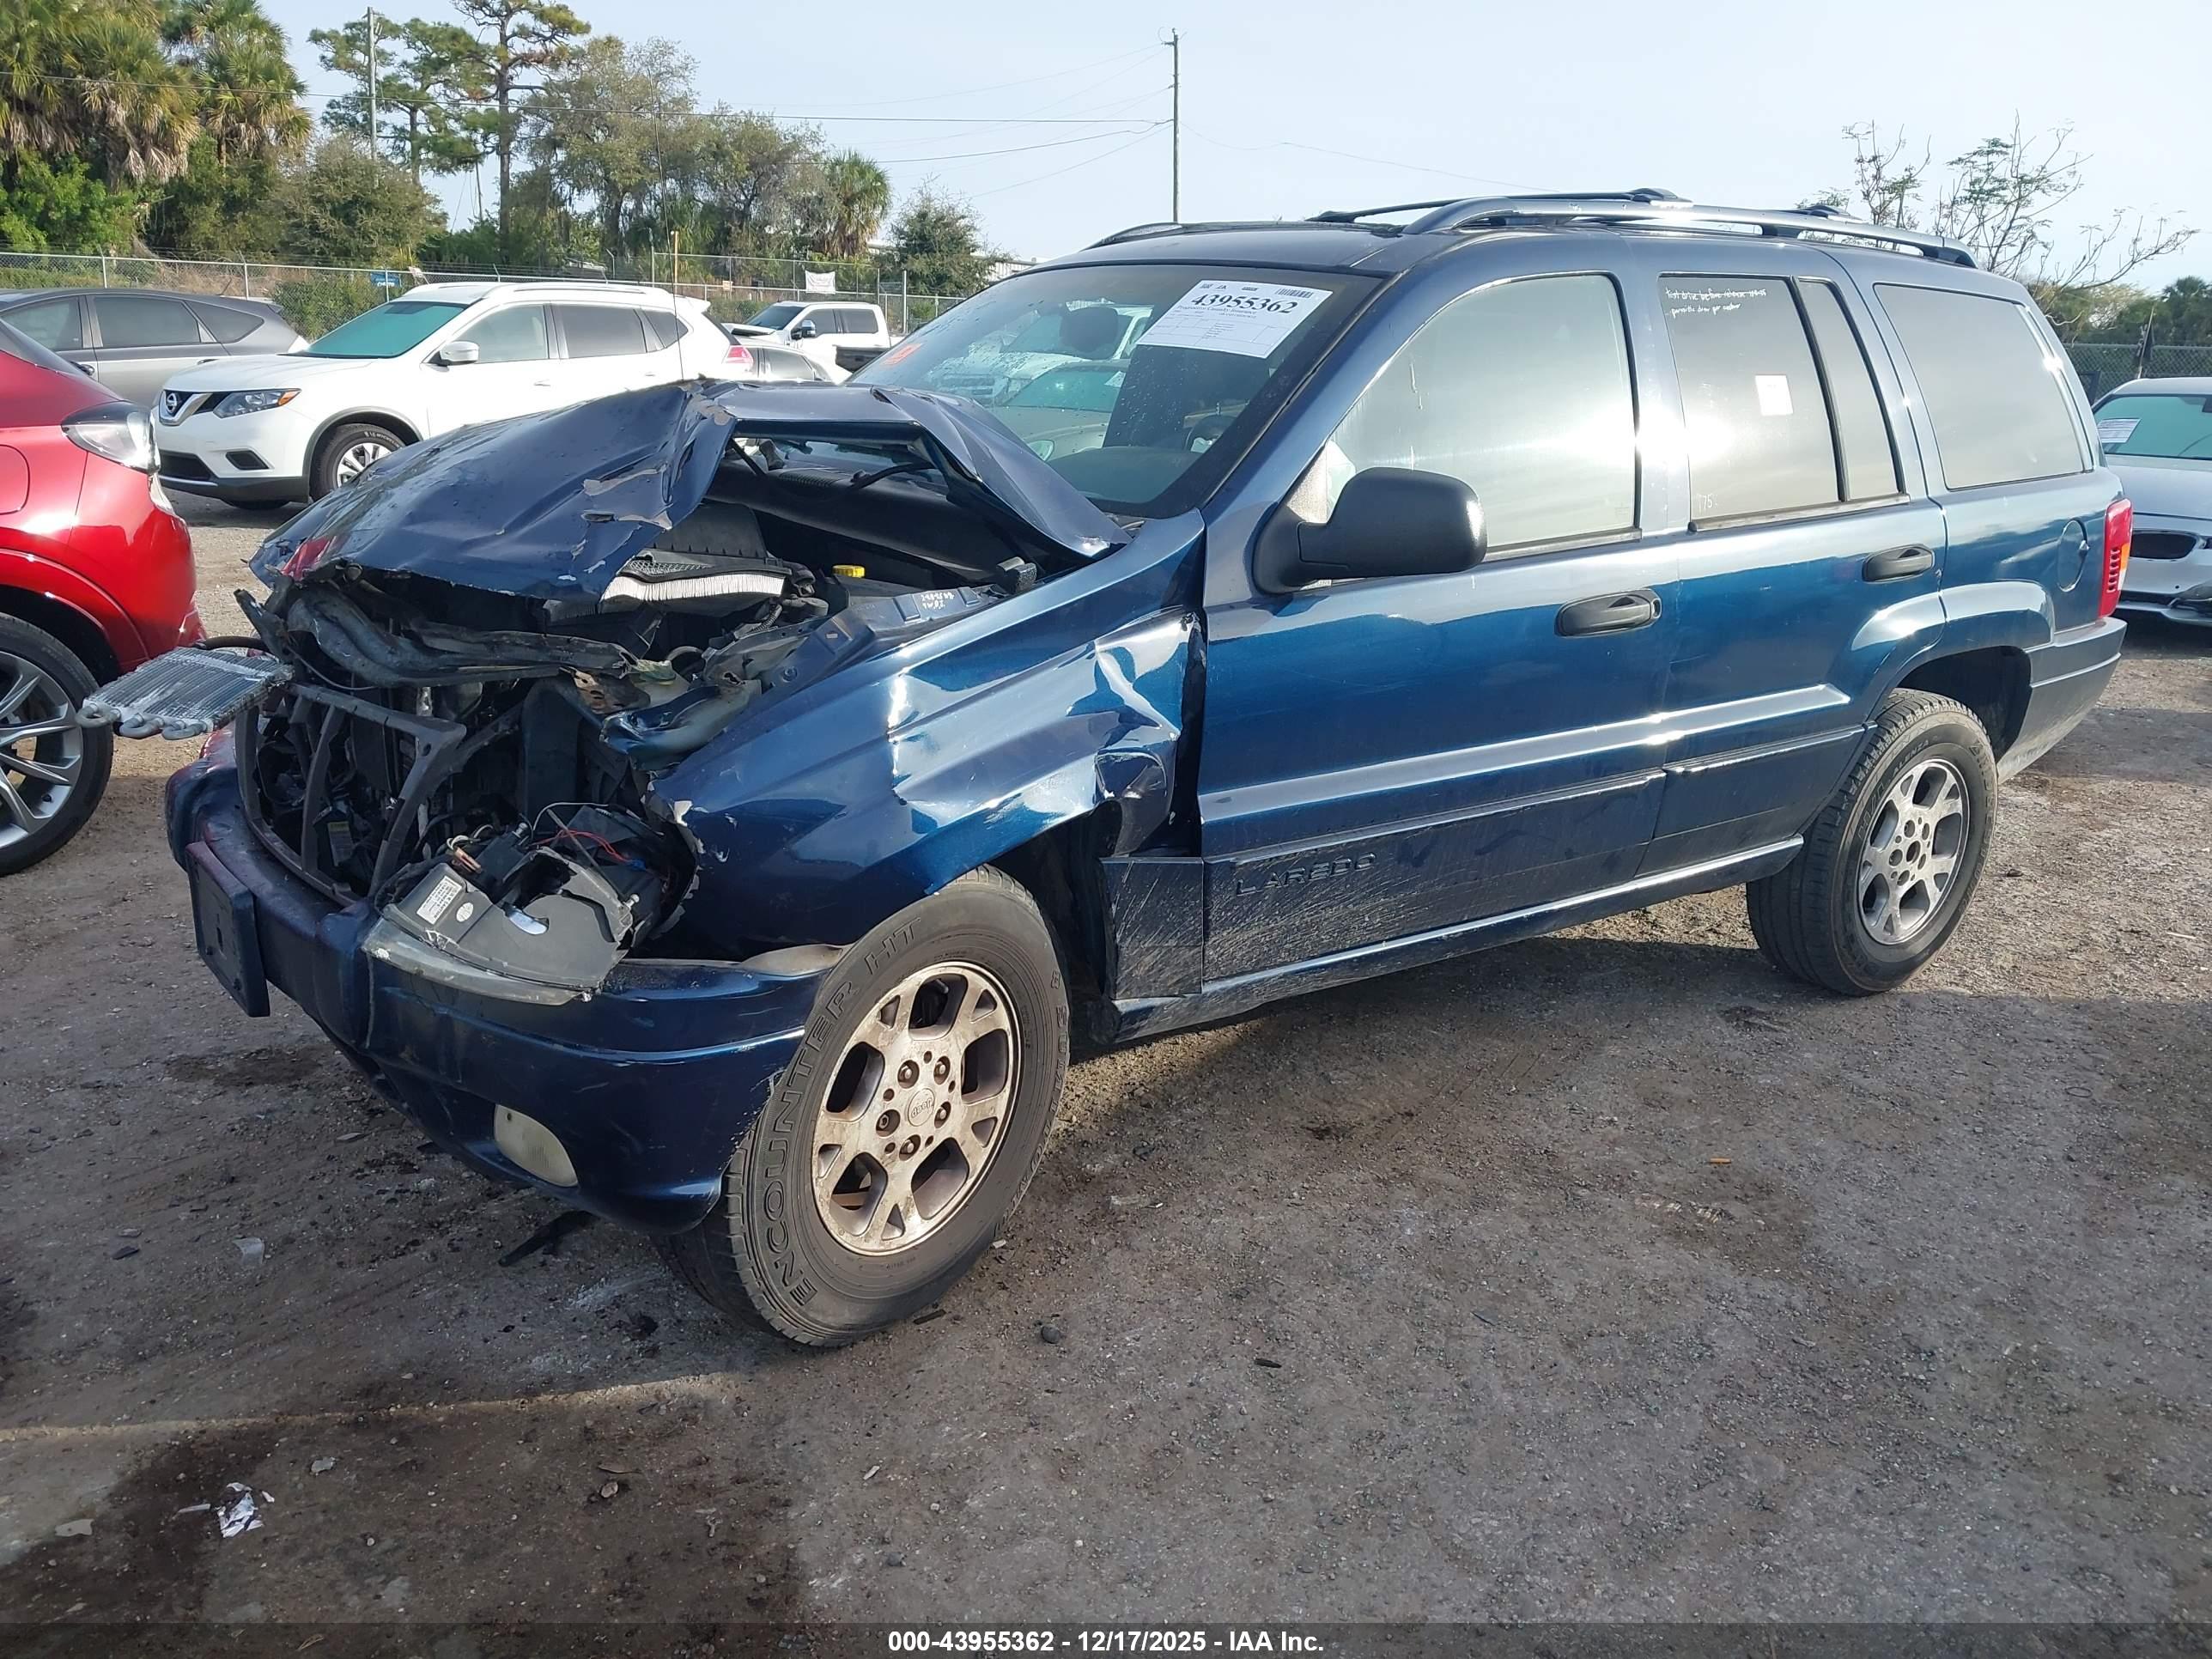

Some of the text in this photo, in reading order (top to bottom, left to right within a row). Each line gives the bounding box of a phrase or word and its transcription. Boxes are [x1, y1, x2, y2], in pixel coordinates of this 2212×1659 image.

[1191, 293, 1298, 314] 43955362
[1236, 852, 1377, 897] LAREDO
[763, 980, 857, 1307] ENCOUNTER
